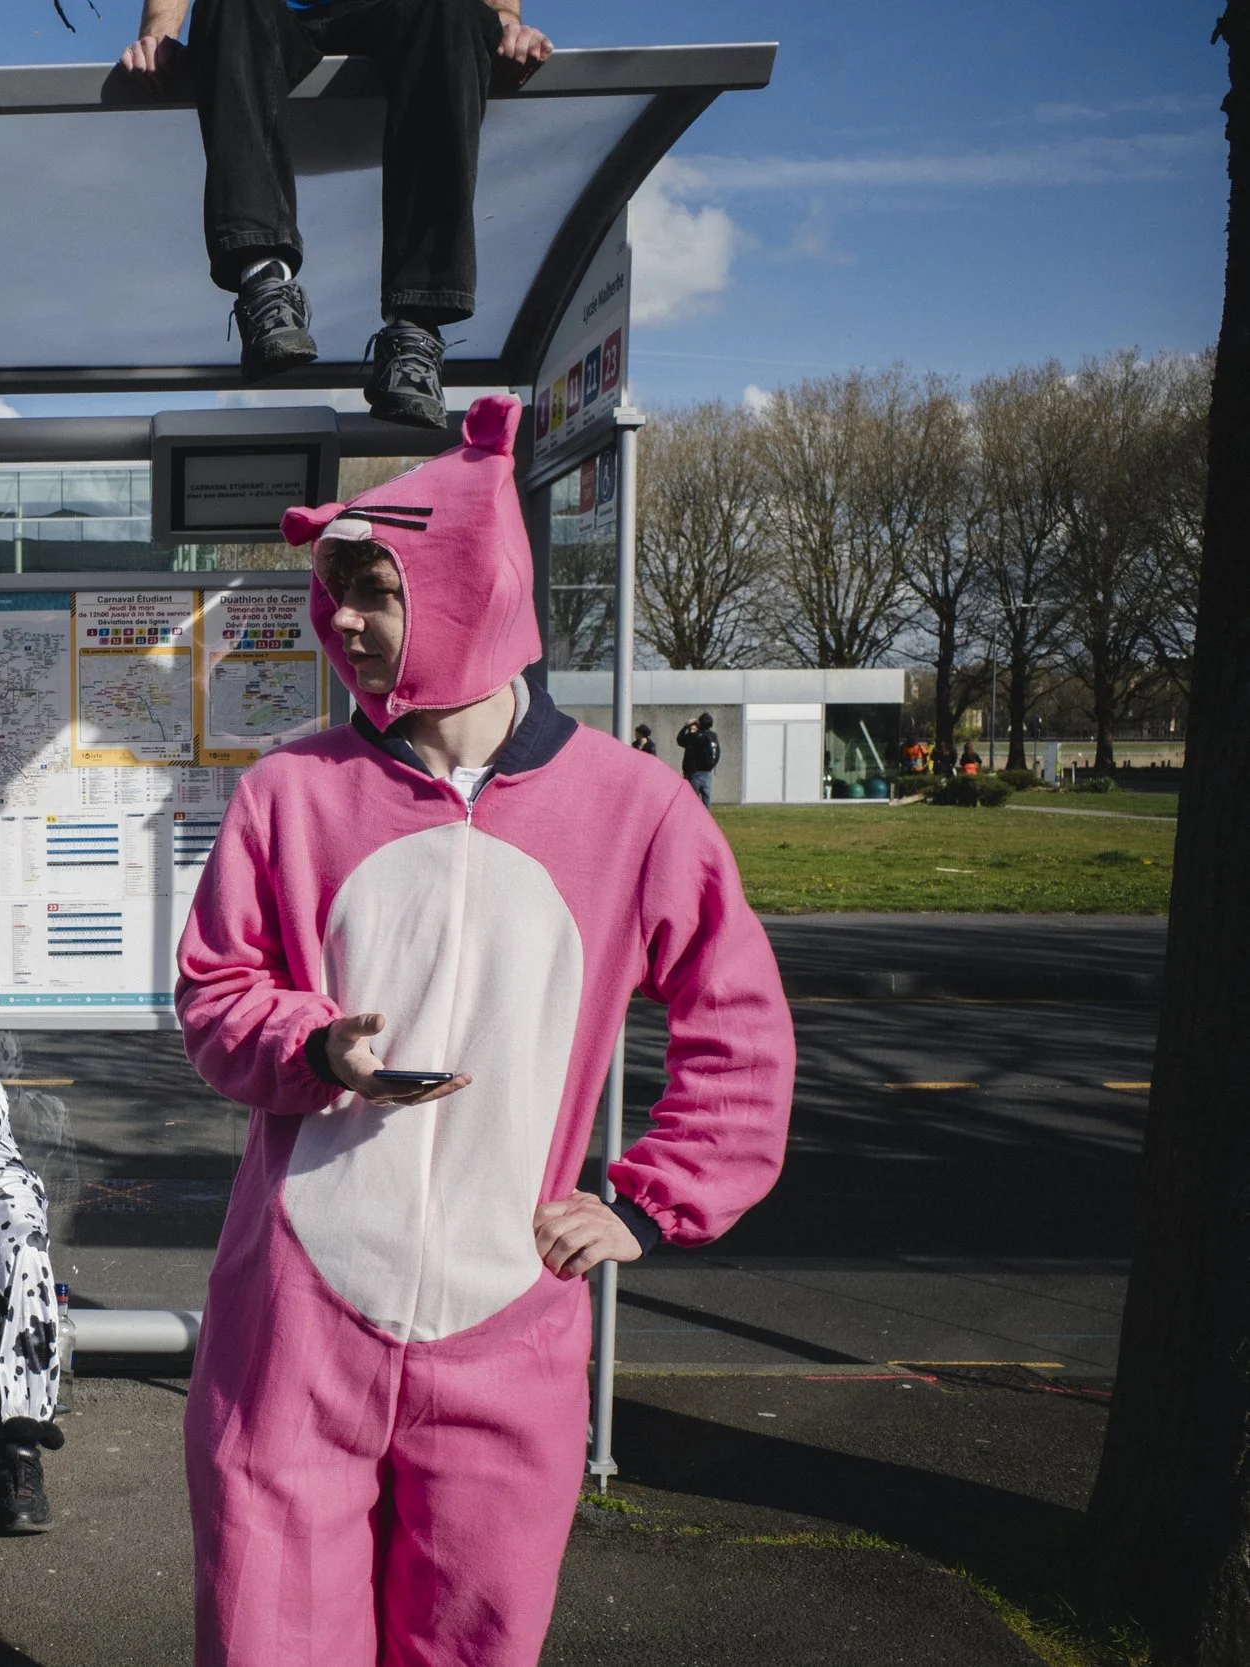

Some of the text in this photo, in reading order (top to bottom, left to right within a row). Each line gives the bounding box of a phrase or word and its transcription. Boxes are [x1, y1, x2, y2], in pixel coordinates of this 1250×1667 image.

[583, 296, 598, 325] Lycée
[598, 272, 624, 307] Malherbe
[569, 375, 579, 407] 11
[586, 360, 597, 394] 21
[605, 345, 616, 380] 23
[137, 594, 172, 603] Étudiant
[220, 595, 306, 604] Duathlon de Caen
[277, 621, 299, 629] lignes
